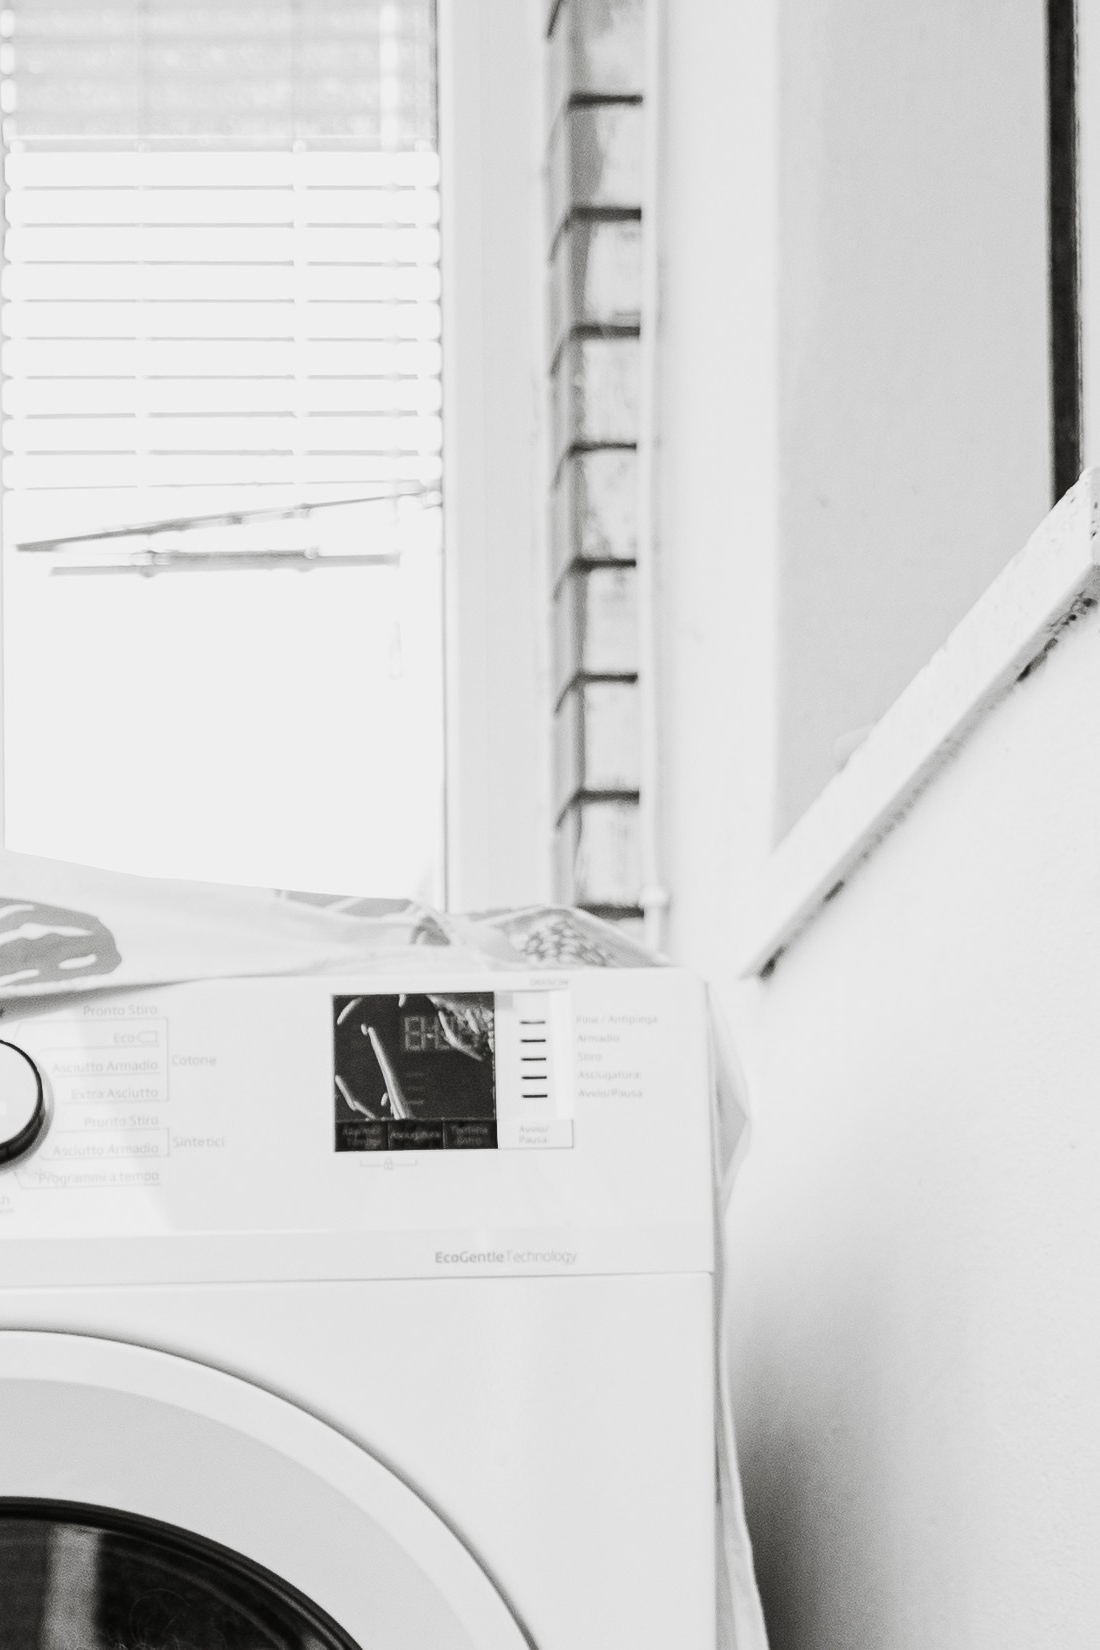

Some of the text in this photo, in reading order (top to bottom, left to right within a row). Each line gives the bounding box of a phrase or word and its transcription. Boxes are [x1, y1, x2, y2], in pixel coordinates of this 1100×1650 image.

[83, 1004, 157, 1016] Pronto Stiro
[113, 1033, 135, 1043] Eco
[577, 1033, 620, 1043] Armadio
[172, 1055, 217, 1066] Cotone
[577, 1052, 602, 1062] Stiro
[52, 1060, 158, 1073] Asciutto Armadio
[71, 1087, 158, 1100] Extra Asciutto
[84, 1114, 158, 1127] Pronto Stiro
[172, 1136, 225, 1148] Sintetici
[53, 1143, 159, 1156] Asciutto Armadio
[39, 1172, 106, 1187] Programmi
[119, 1171, 159, 1186] tempo
